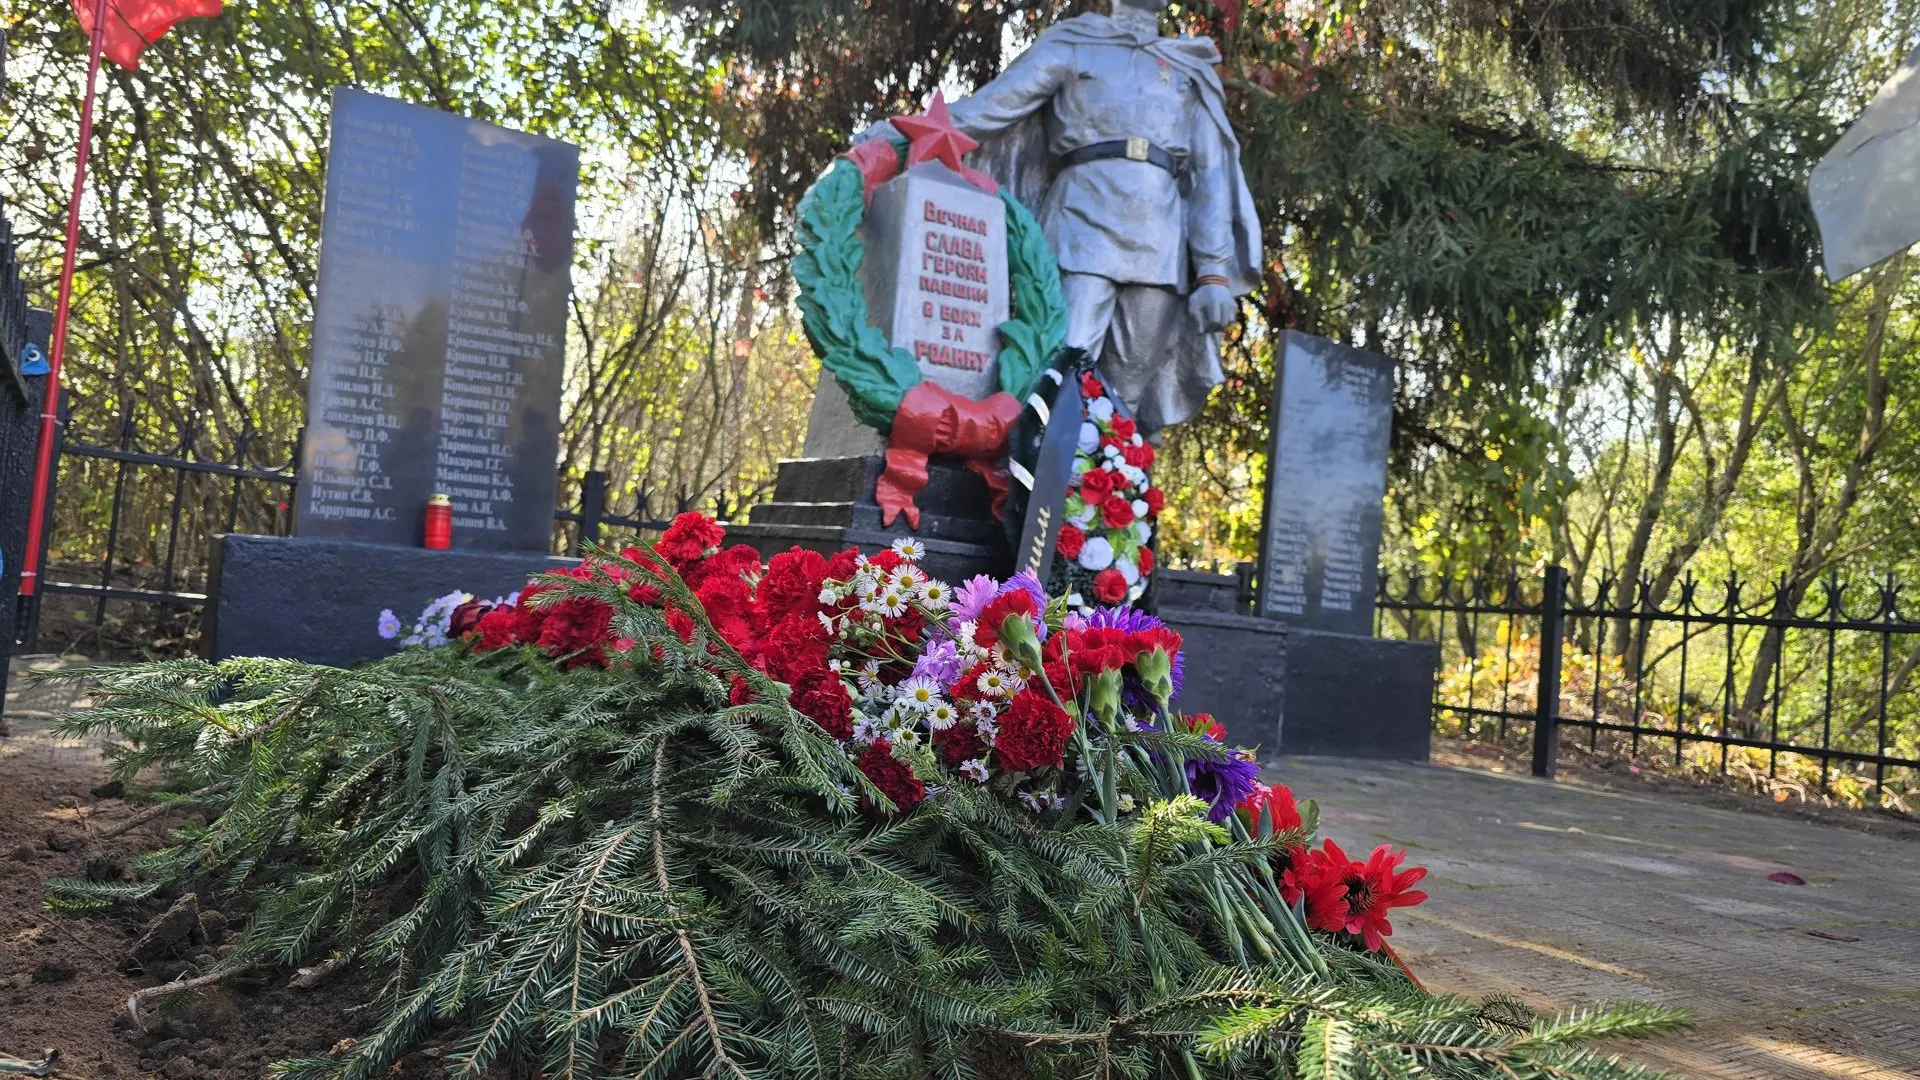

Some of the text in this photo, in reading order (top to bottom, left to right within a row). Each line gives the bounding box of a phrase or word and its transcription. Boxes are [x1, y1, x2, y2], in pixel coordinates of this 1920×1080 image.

[925, 232, 985, 263] СЛАВА
[922, 252, 988, 284] ГЕРОЯМ
[919, 276, 989, 304] ПАВШИМ
[922, 301, 933, 318] В
[942, 326, 964, 342] ЗА
[914, 339, 992, 373] РОДИНУ
